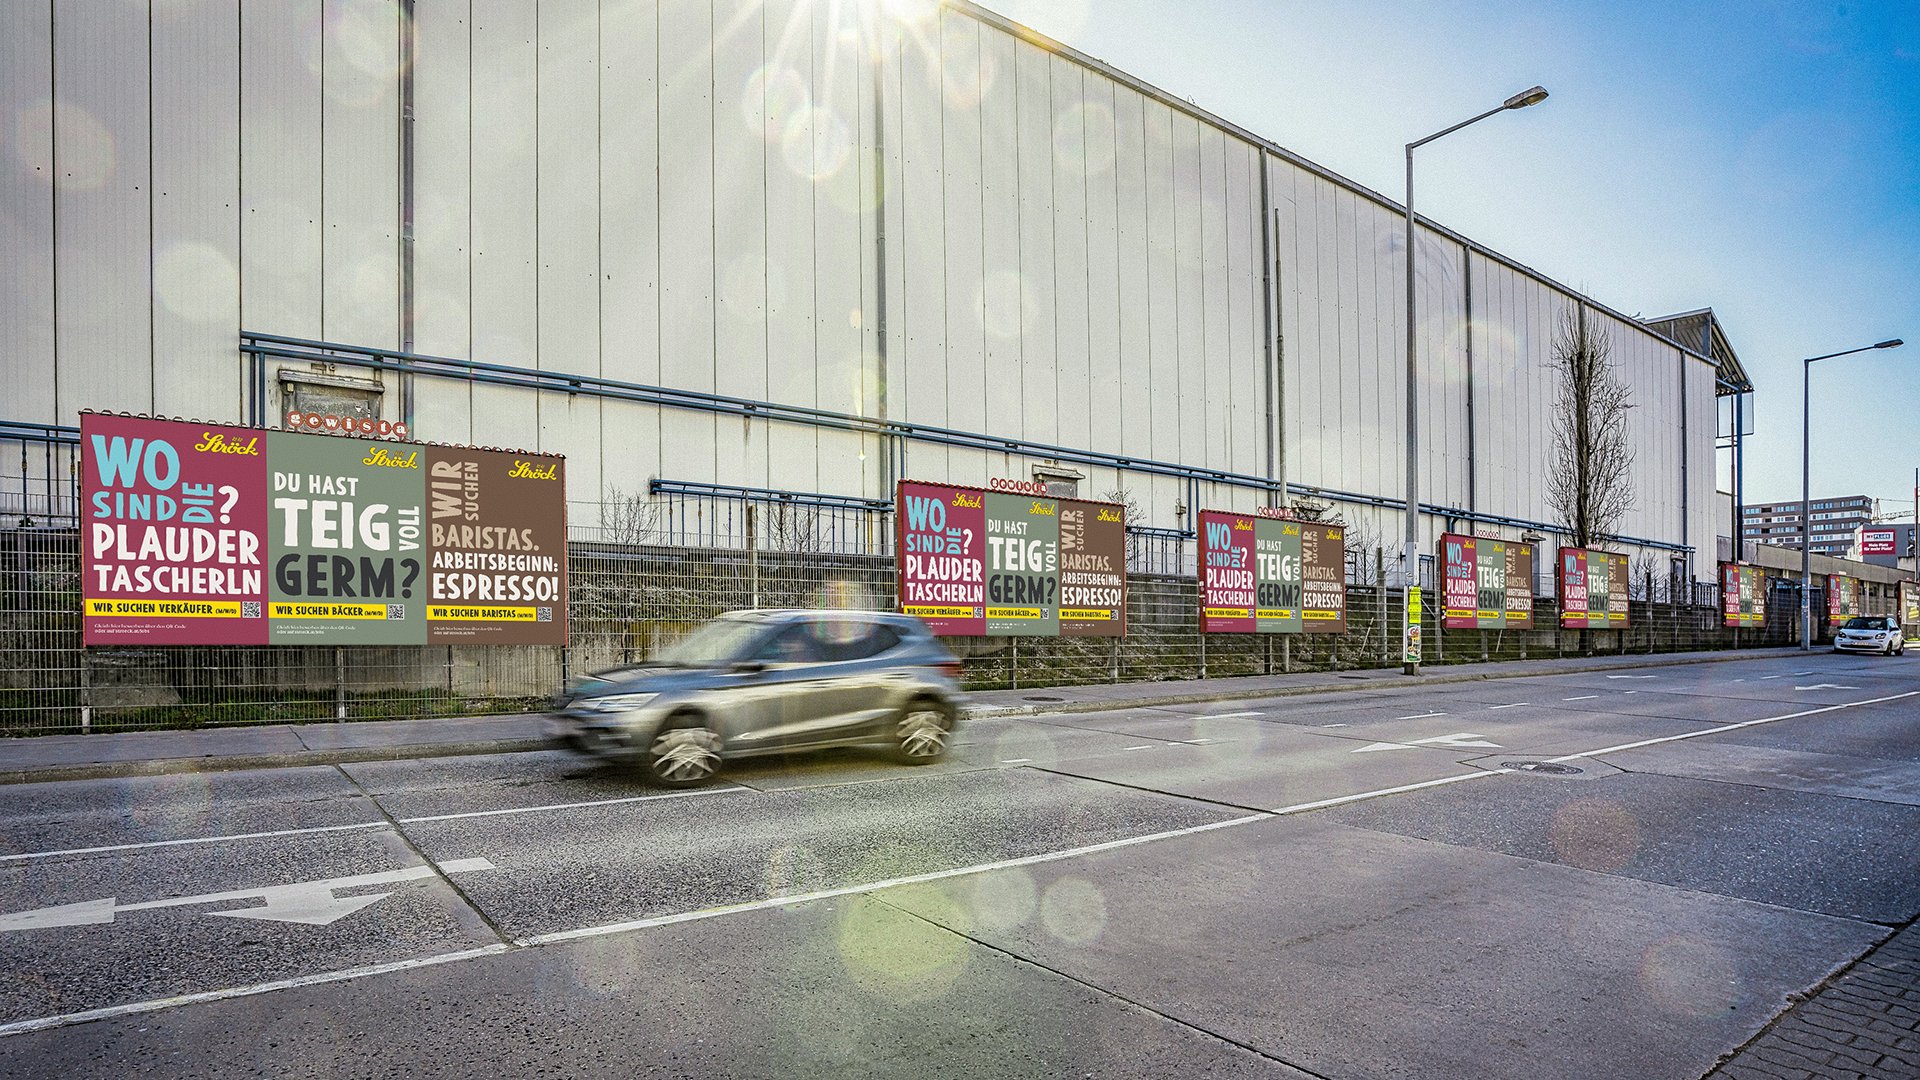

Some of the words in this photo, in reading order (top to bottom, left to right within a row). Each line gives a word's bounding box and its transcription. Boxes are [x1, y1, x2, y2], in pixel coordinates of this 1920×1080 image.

[289, 412, 407, 436] gewista
[194, 432, 258, 456] Ströck
[91, 434, 180, 490] WO
[362, 447, 418, 469] Ströck
[508, 460, 556, 481] Ströck
[274, 472, 300, 492] DU
[309, 475, 358, 496] HAST
[431, 461, 462, 518] WIR
[465, 462, 478, 521] SUCHEN
[92, 491, 177, 520] SIND
[182, 482, 214, 523] DIE
[218, 485, 239, 524] ?
[952, 492, 981, 508] Ströck
[1029, 502, 1055, 516] Ströck
[274, 498, 390, 551] TEIG
[906, 495, 946, 532] WO
[1097, 508, 1121, 522] Ströck
[398, 506, 420, 551] VOLL
[432, 524, 539, 551] BARISTAS.
[988, 519, 1000, 533] DU
[1004, 520, 1027, 535] HAST
[1061, 510, 1076, 550] WIR
[1206, 522, 1231, 550] WO
[92, 523, 260, 564] PLAUDER
[906, 533, 945, 553] SIND
[946, 527, 961, 554] DIE
[963, 529, 973, 555] ?
[1257, 539, 1265, 550] DU
[1266, 540, 1282, 551] HAST
[1303, 530, 1313, 563] WIR
[432, 552, 558, 572] ARBEITSBEGINN:
[988, 536, 1042, 572] TEIG
[1045, 541, 1056, 572] VOLL
[1062, 553, 1112, 571] BARISTAS.
[1206, 552, 1230, 567] SIND
[1231, 546, 1240, 568] DIE
[1241, 547, 1248, 568] ?
[1447, 542, 1462, 564] WO
[1565, 554, 1576, 574] WO
[276, 554, 420, 599] GERM?
[906, 555, 982, 582] PLAUDER
[1257, 553, 1291, 581] TEIG
[1303, 566, 1336, 580] BARISTAS.
[1447, 565, 1461, 577] SIND
[1478, 566, 1499, 588] TEIG
[93, 565, 261, 595] TASCHERLN
[432, 573, 558, 601] ESPRESSO!
[989, 574, 1056, 604] GERM?
[1062, 572, 1121, 586] ARBEITSBEGINN:
[1206, 568, 1254, 590] PLAUDER
[1447, 578, 1476, 595] PLAUDER
[907, 583, 983, 602] TASCHERLN
[1062, 587, 1122, 606] ESPRESSO!
[1207, 590, 1254, 605] TASCHERLN
[1258, 583, 1300, 607] GERM?
[1303, 592, 1343, 608] ESPRESSO!
[1447, 595, 1476, 608] TASCHERLN
[1478, 590, 1504, 609] GERM?
[94, 603, 113, 612] WIR
[117, 603, 155, 613] SUCHEN
[159, 603, 212, 614] VERKÄUFER
[276, 606, 292, 615] WIR
[296, 606, 328, 615] SUCHEN
[332, 605, 363, 616] BÄCKER
[433, 608, 447, 617] WIR
[450, 609, 479, 617] SUCHEN
[482, 609, 516, 618] BARISTAS
